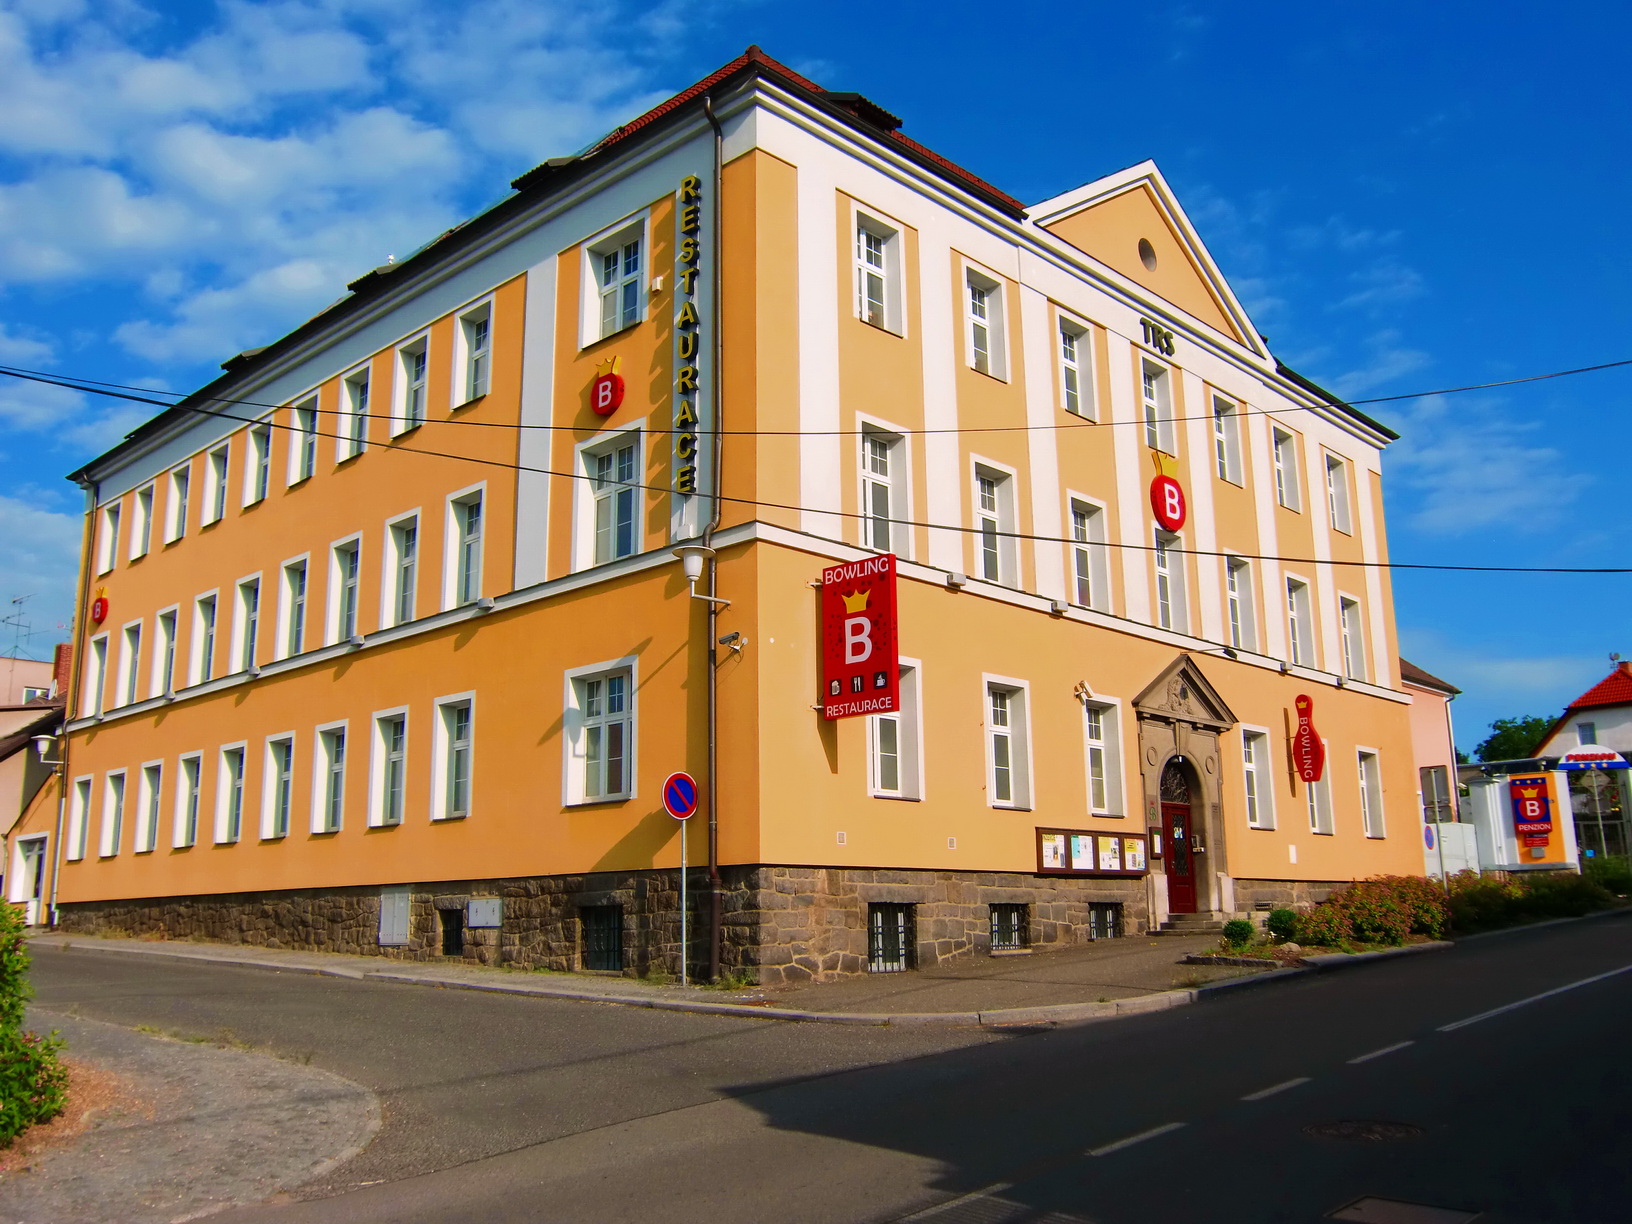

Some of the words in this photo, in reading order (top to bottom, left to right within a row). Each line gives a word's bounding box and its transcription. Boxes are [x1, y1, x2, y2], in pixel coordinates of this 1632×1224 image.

[676, 174, 699, 493] RESTAURACE
[1140, 316, 1175, 357] TRS
[598, 380, 612, 408] B
[1164, 482, 1181, 520] B
[825, 557, 889, 585] BOWLING
[94, 602, 102, 619] B
[844, 616, 873, 665] B
[826, 697, 892, 717] RESTAURACE
[1300, 716, 1314, 779] BOWLING
[1525, 800, 1540, 816] B
[1518, 823, 1551, 831] PENZION
